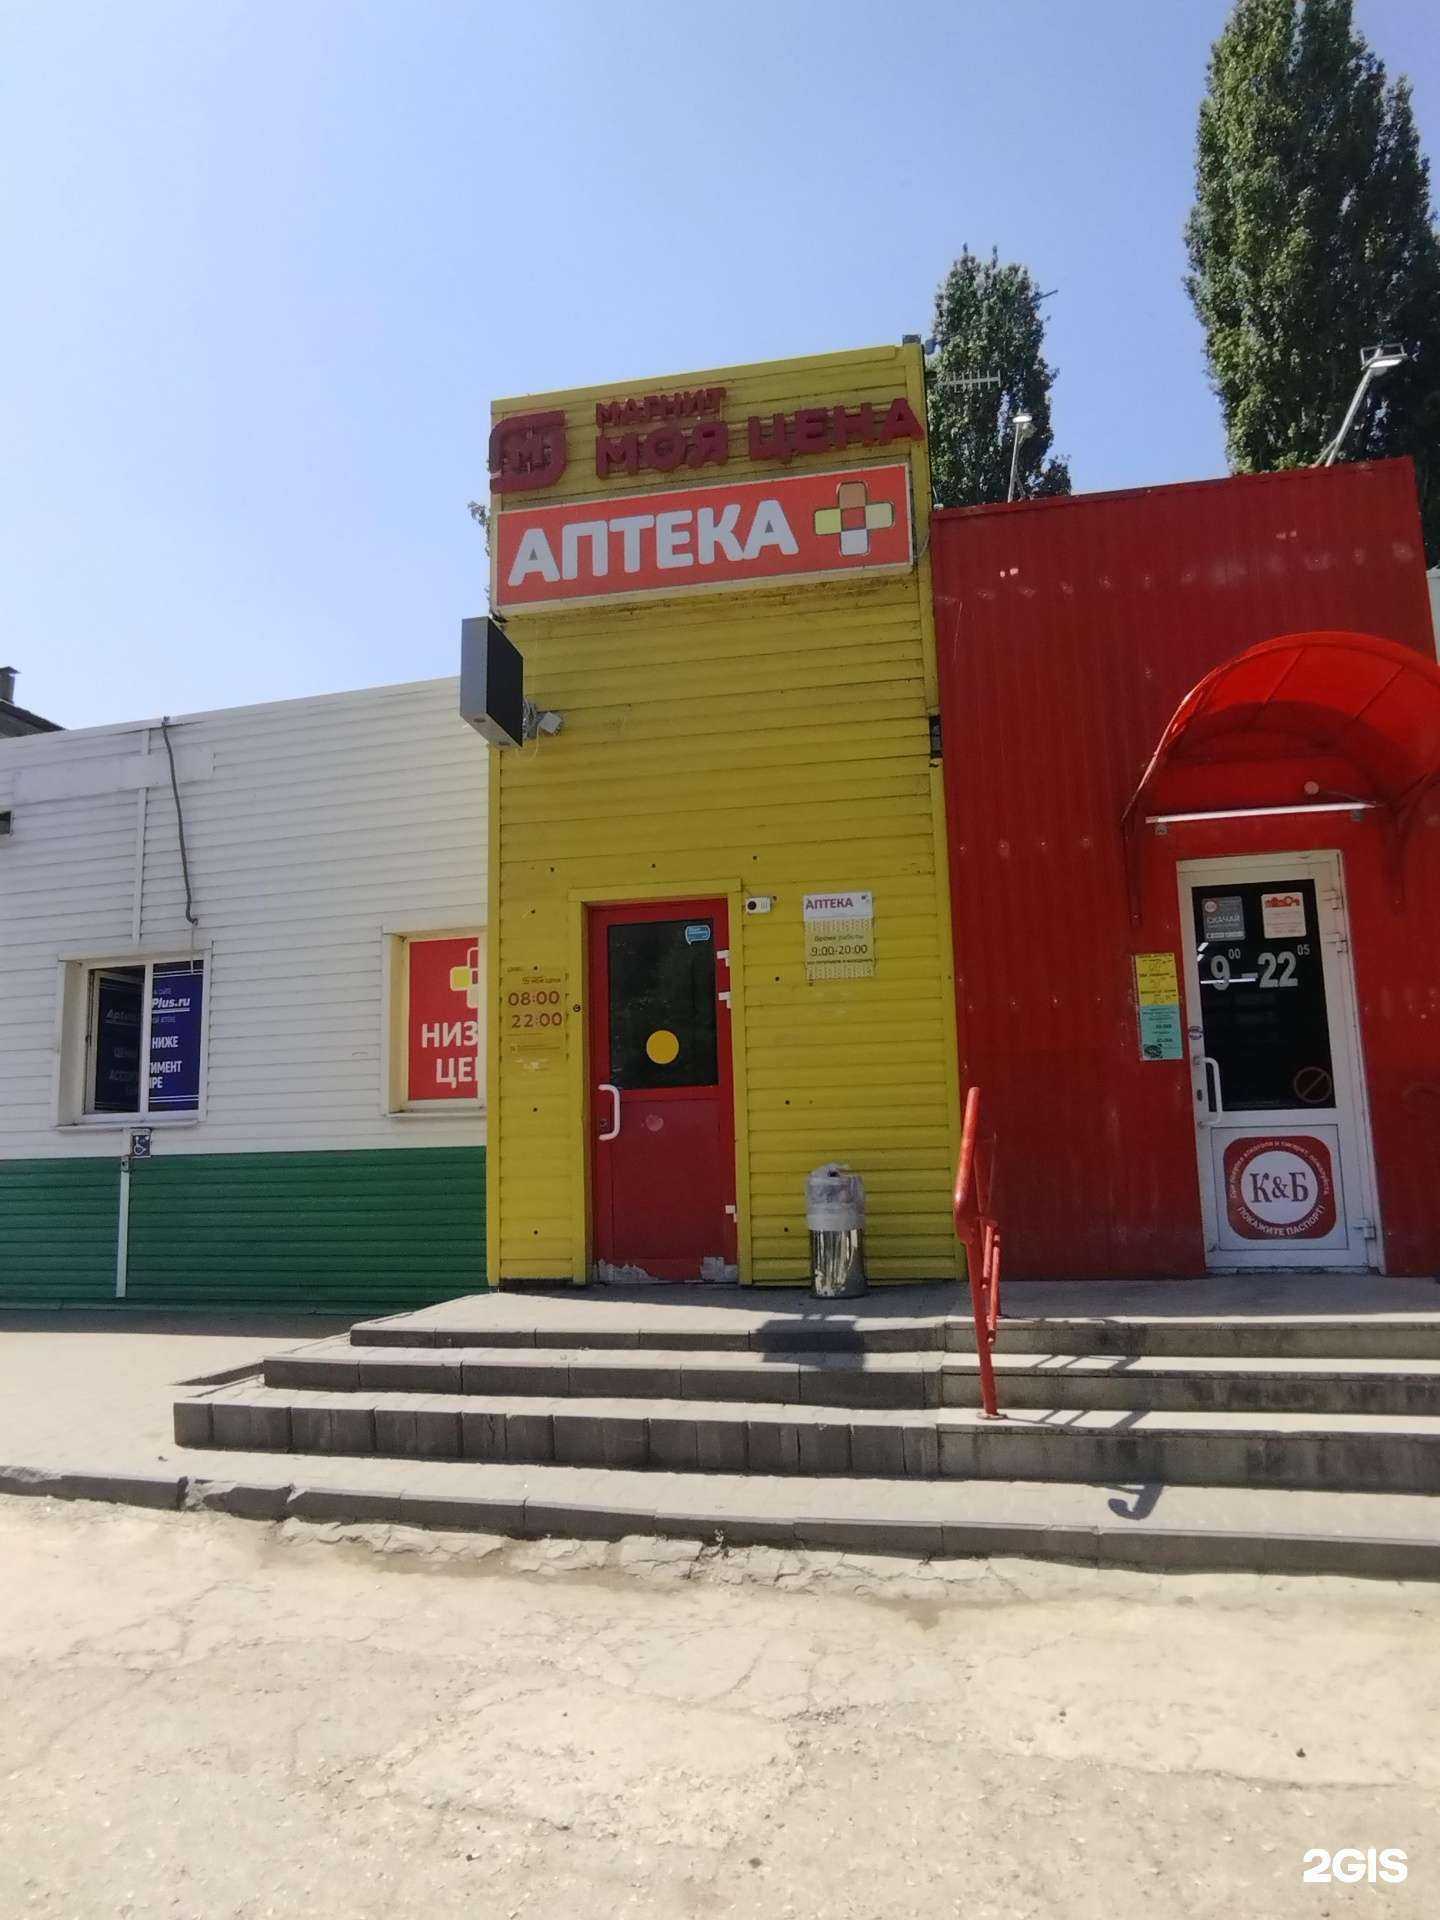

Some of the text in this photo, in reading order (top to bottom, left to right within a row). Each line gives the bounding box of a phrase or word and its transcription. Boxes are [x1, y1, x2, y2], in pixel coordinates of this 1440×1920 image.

[595, 398, 926, 480] МОЯ ЦЕНА
[508, 499, 799, 586] АПТЕКА
[805, 897, 854, 910] АПТЕКА
[1210, 955, 1231, 991] 9
[1257, 951, 1299, 988] 22
[508, 990, 560, 1006] 08:00
[511, 1012, 563, 1029] 22:00
[151, 1036, 179, 1049] НИЖЕ
[436, 1056, 478, 1089] ЦЕ
[1248, 1171, 1310, 1204] К&Б
